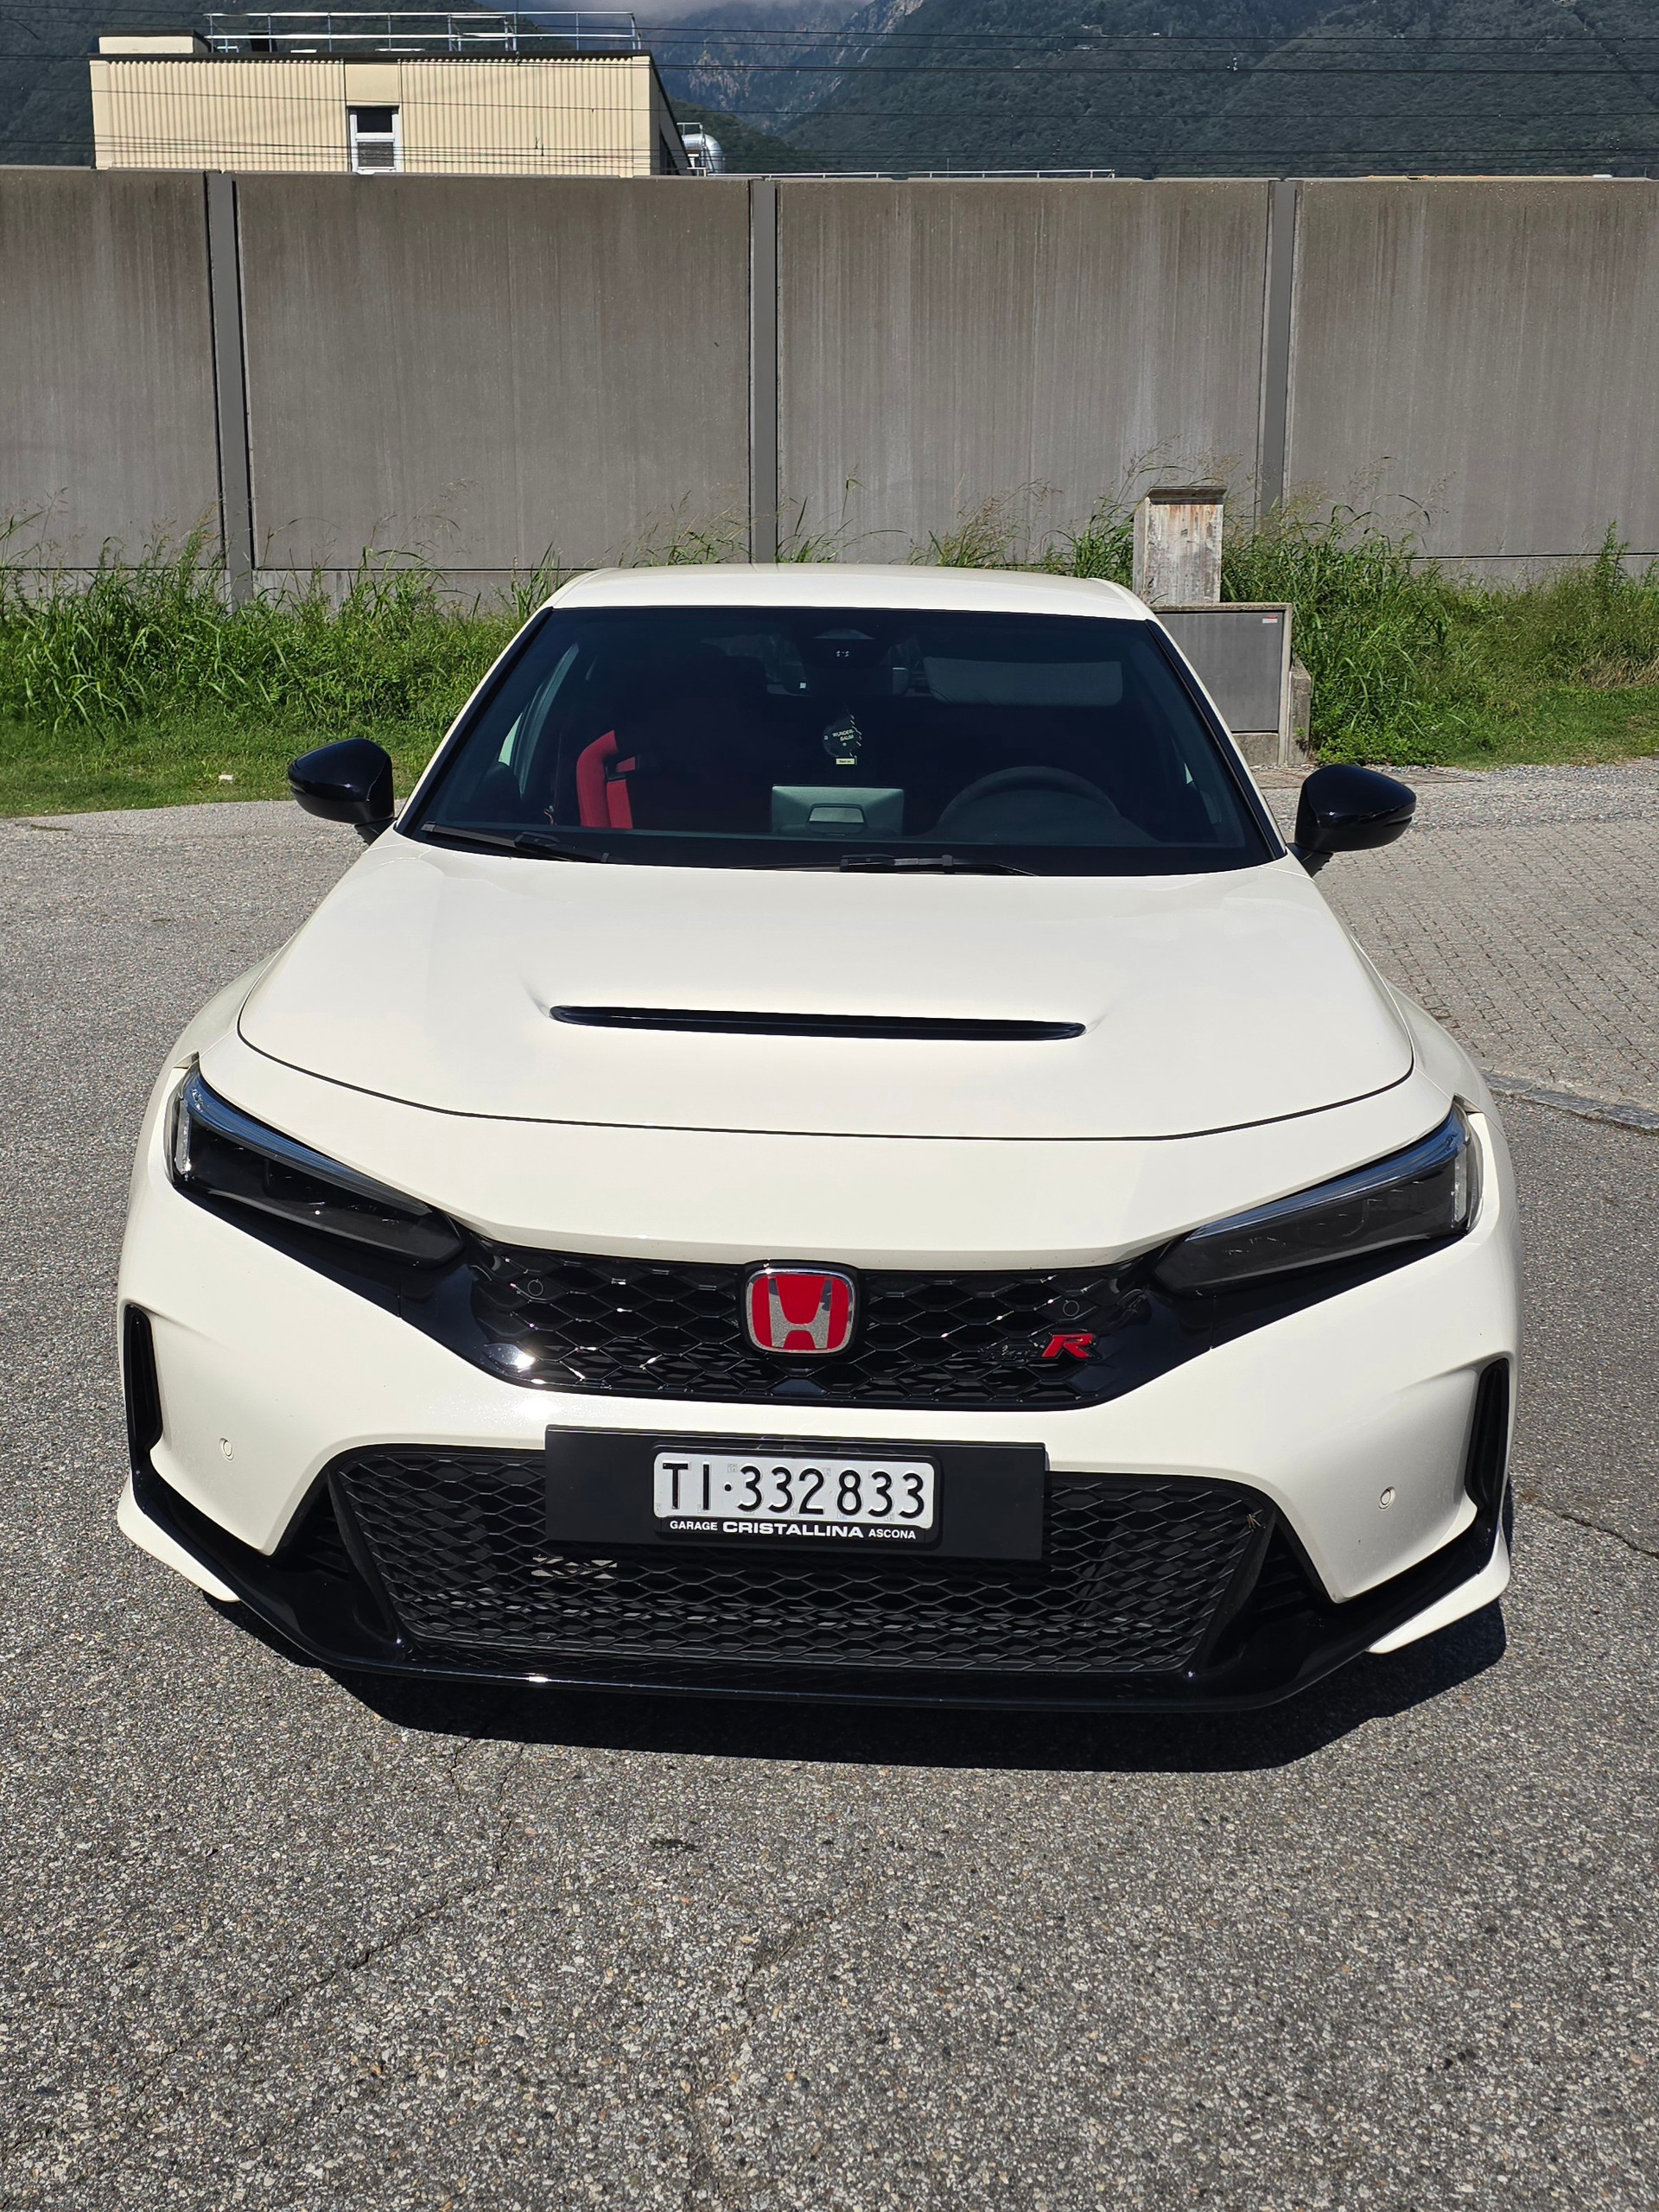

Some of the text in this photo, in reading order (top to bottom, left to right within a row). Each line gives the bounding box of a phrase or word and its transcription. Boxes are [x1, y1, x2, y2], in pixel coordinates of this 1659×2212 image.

[1041, 1332, 1093, 1358] R
[670, 1521, 917, 1540] GARAGE CRISTALLINA ASCONA
